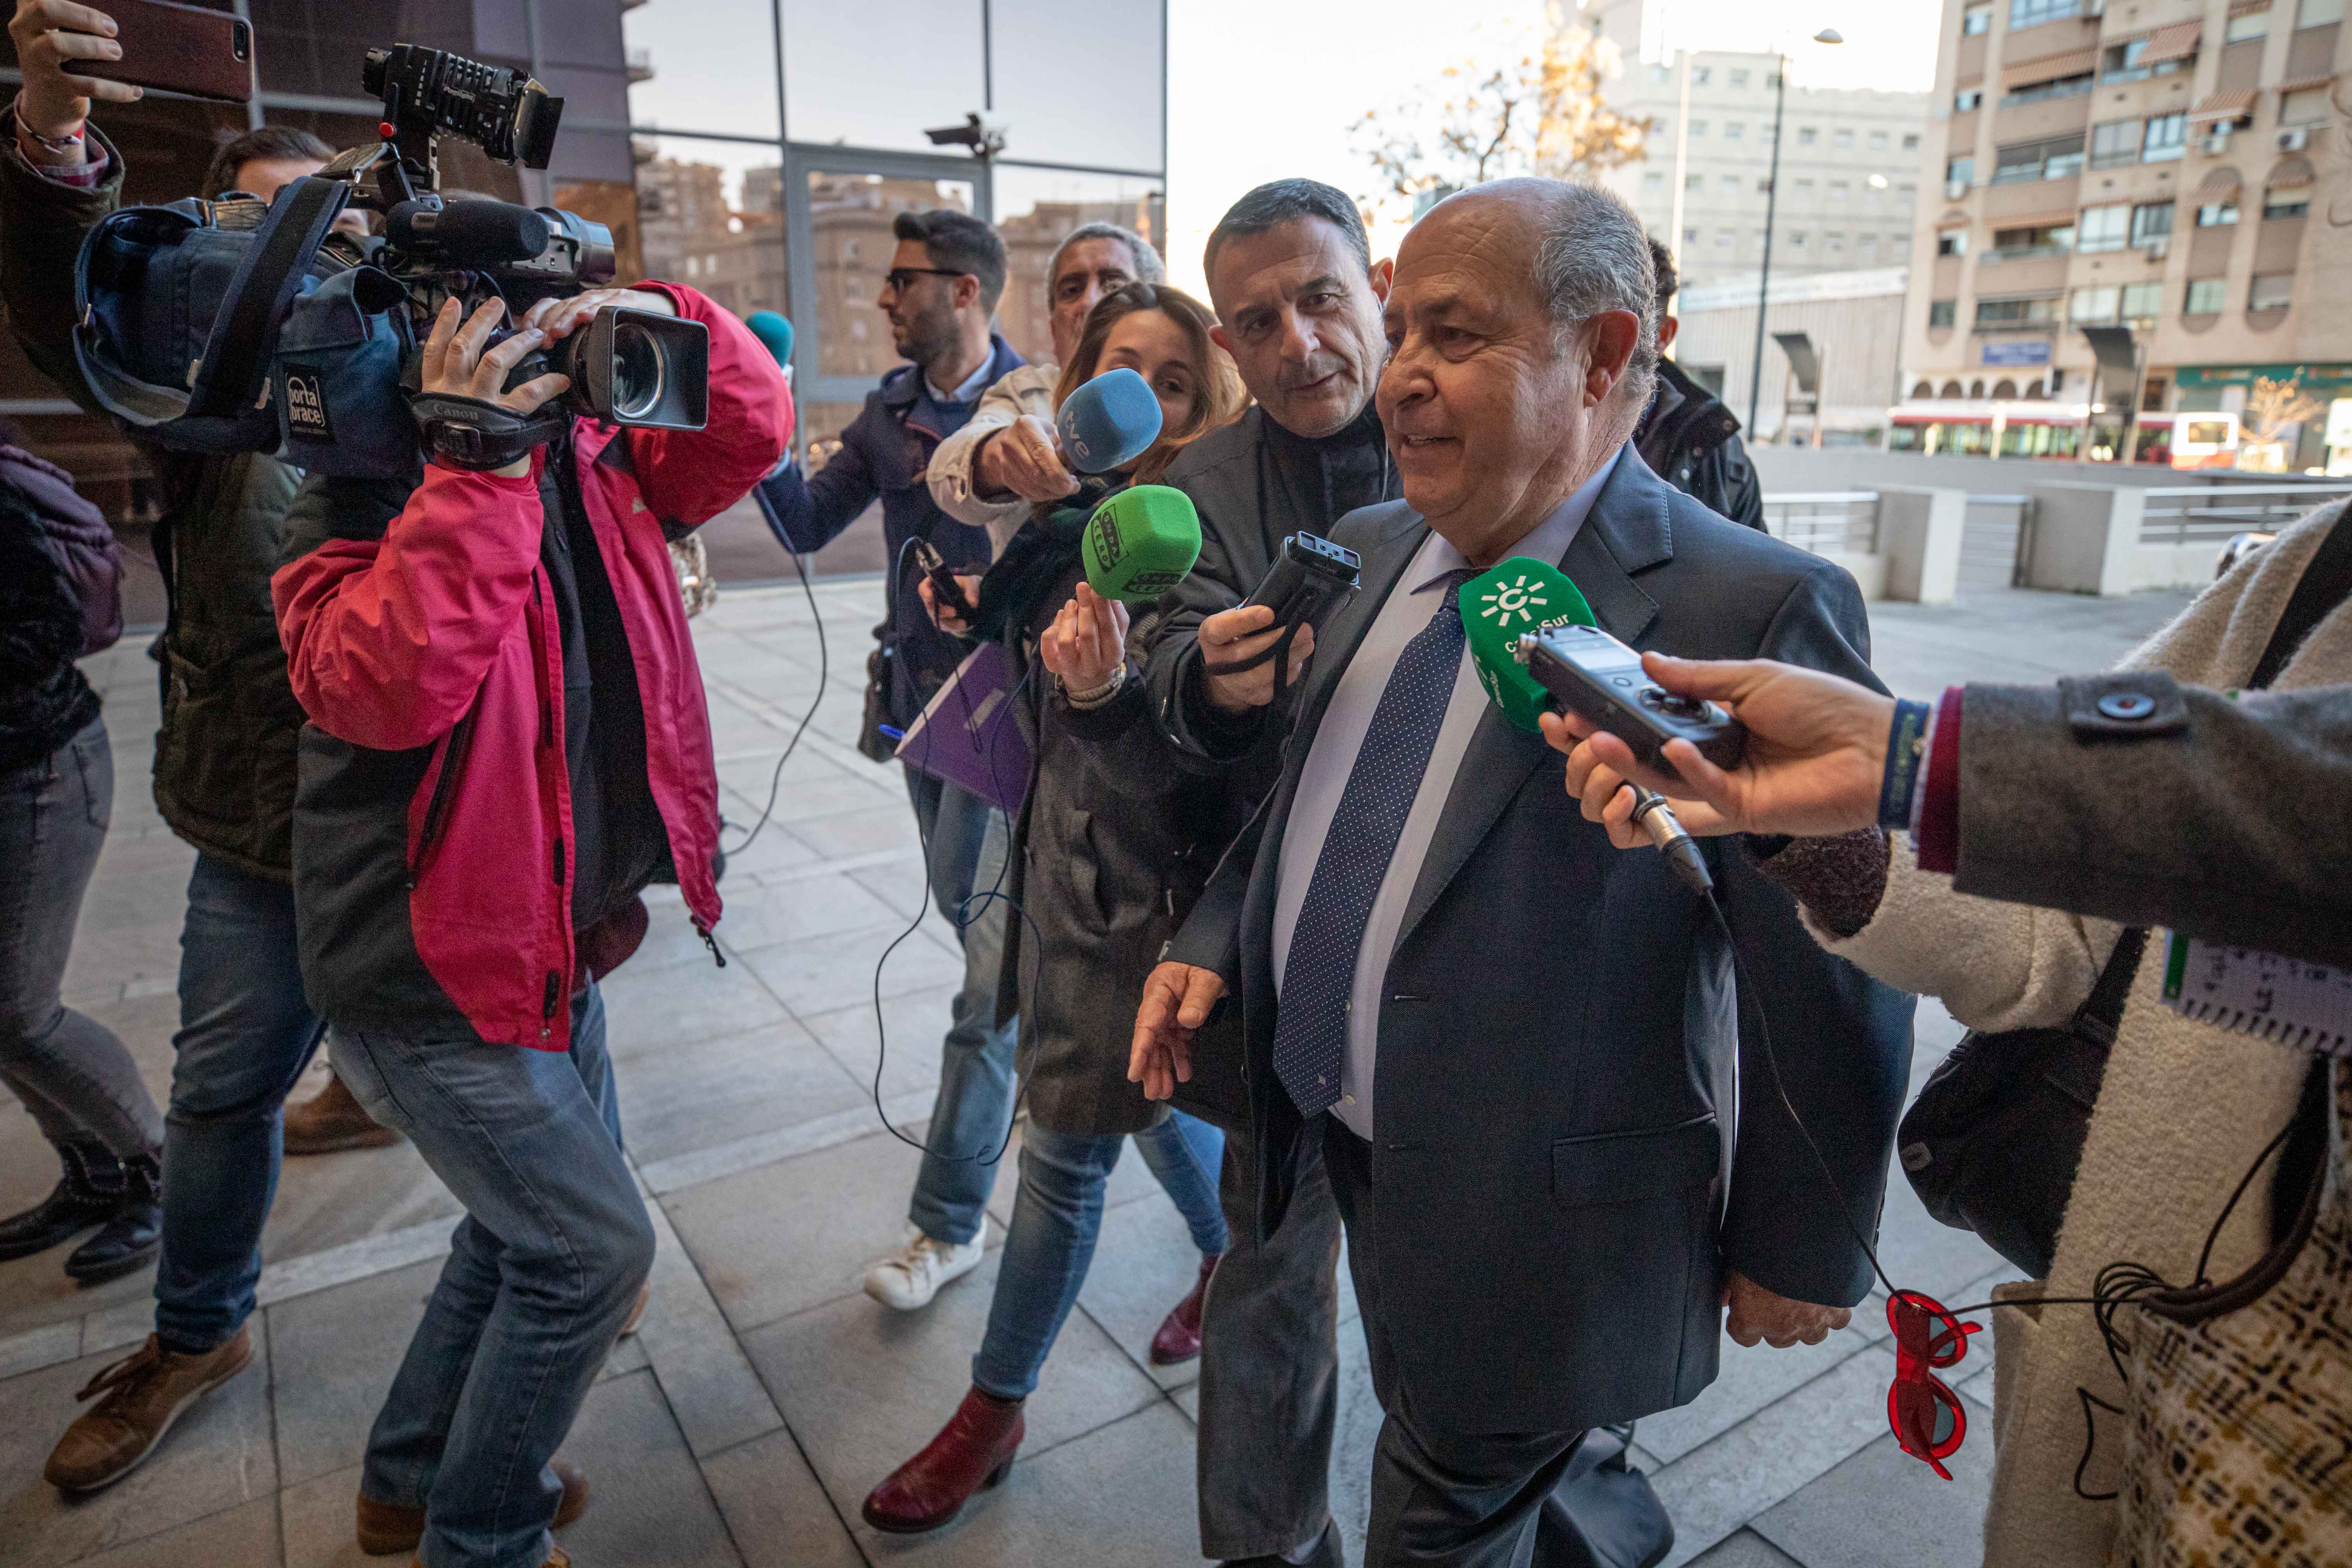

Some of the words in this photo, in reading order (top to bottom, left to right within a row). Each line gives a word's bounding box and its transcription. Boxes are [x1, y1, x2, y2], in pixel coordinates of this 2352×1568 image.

[289, 389, 317, 407] porta
[290, 406, 321, 423] brace
[434, 403, 479, 420] Canon
[1094, 524, 1108, 562] CERO
[1505, 614, 1569, 653] CSur
